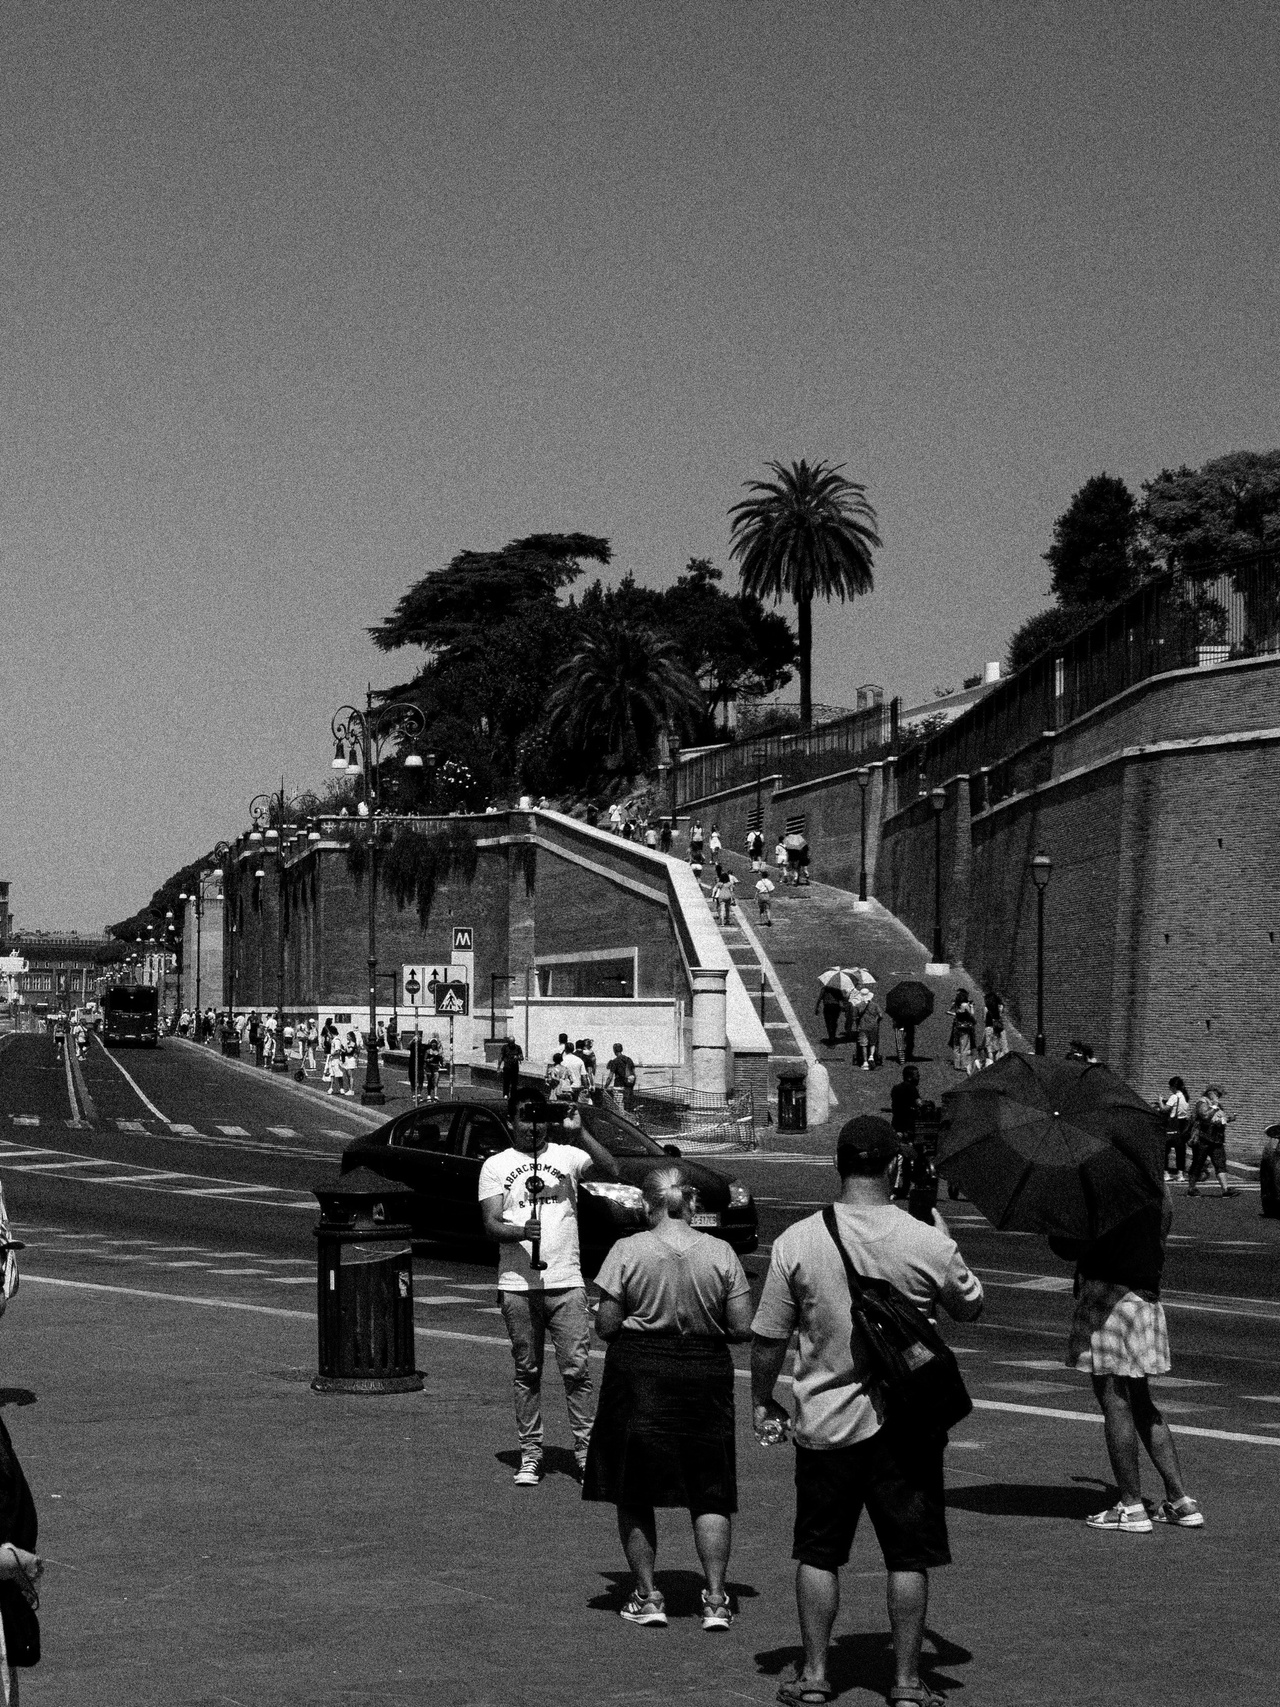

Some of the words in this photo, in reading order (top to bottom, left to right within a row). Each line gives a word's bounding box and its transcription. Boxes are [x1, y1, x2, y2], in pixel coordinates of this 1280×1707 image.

[455, 932, 471, 946] M
[503, 1163, 566, 1191] ABERCROMBIE
[518, 1200, 526, 1208] &
